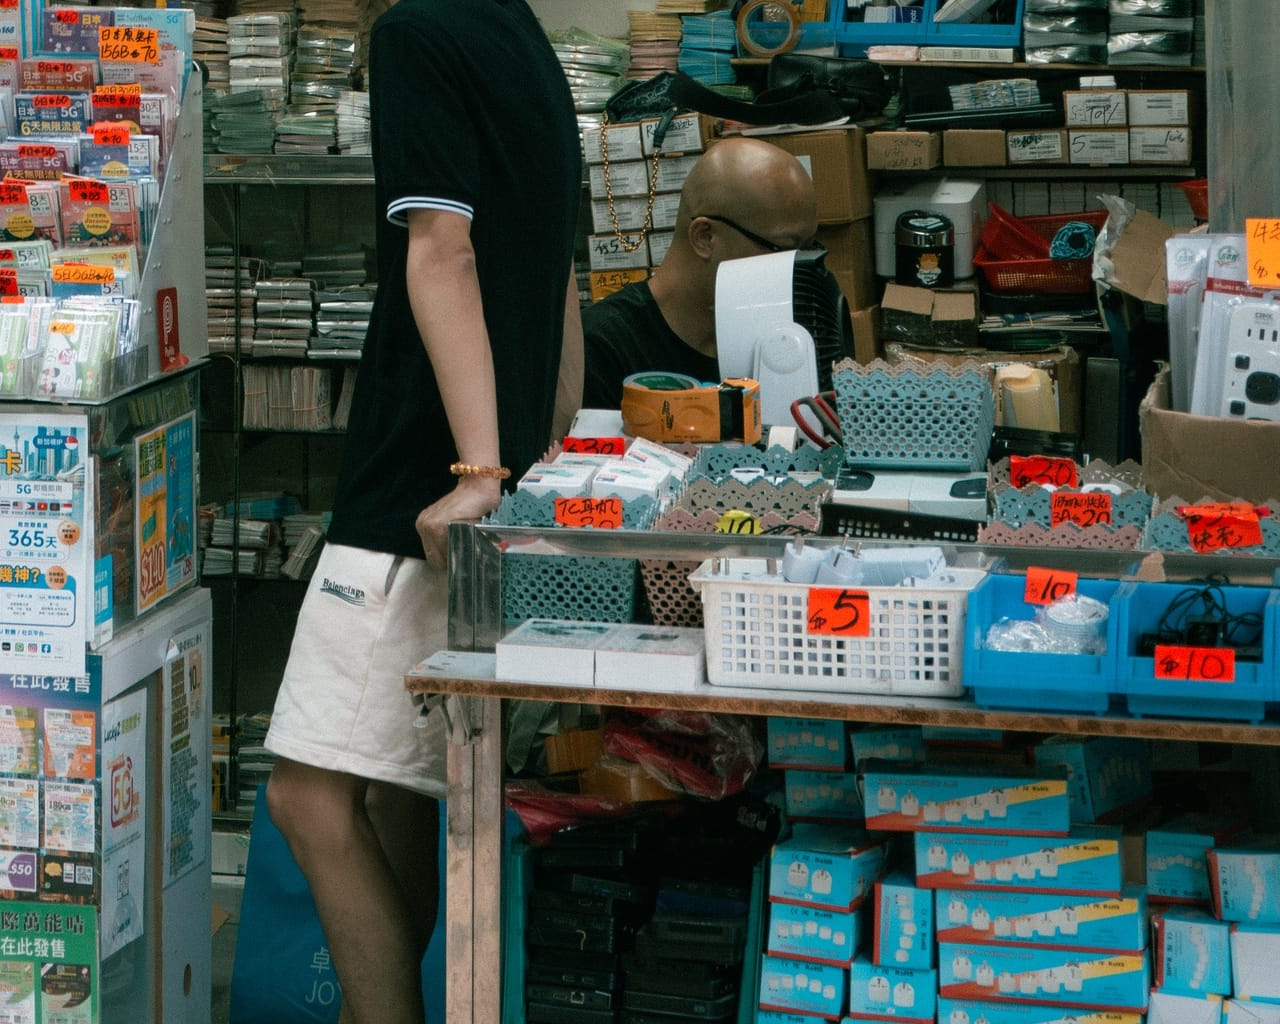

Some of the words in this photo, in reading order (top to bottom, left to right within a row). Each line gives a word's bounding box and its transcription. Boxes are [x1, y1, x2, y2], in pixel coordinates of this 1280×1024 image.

[8, 529, 58, 549] 365天
[9, 863, 32, 876] $50
[0, 936, 65, 958] 在此發售
